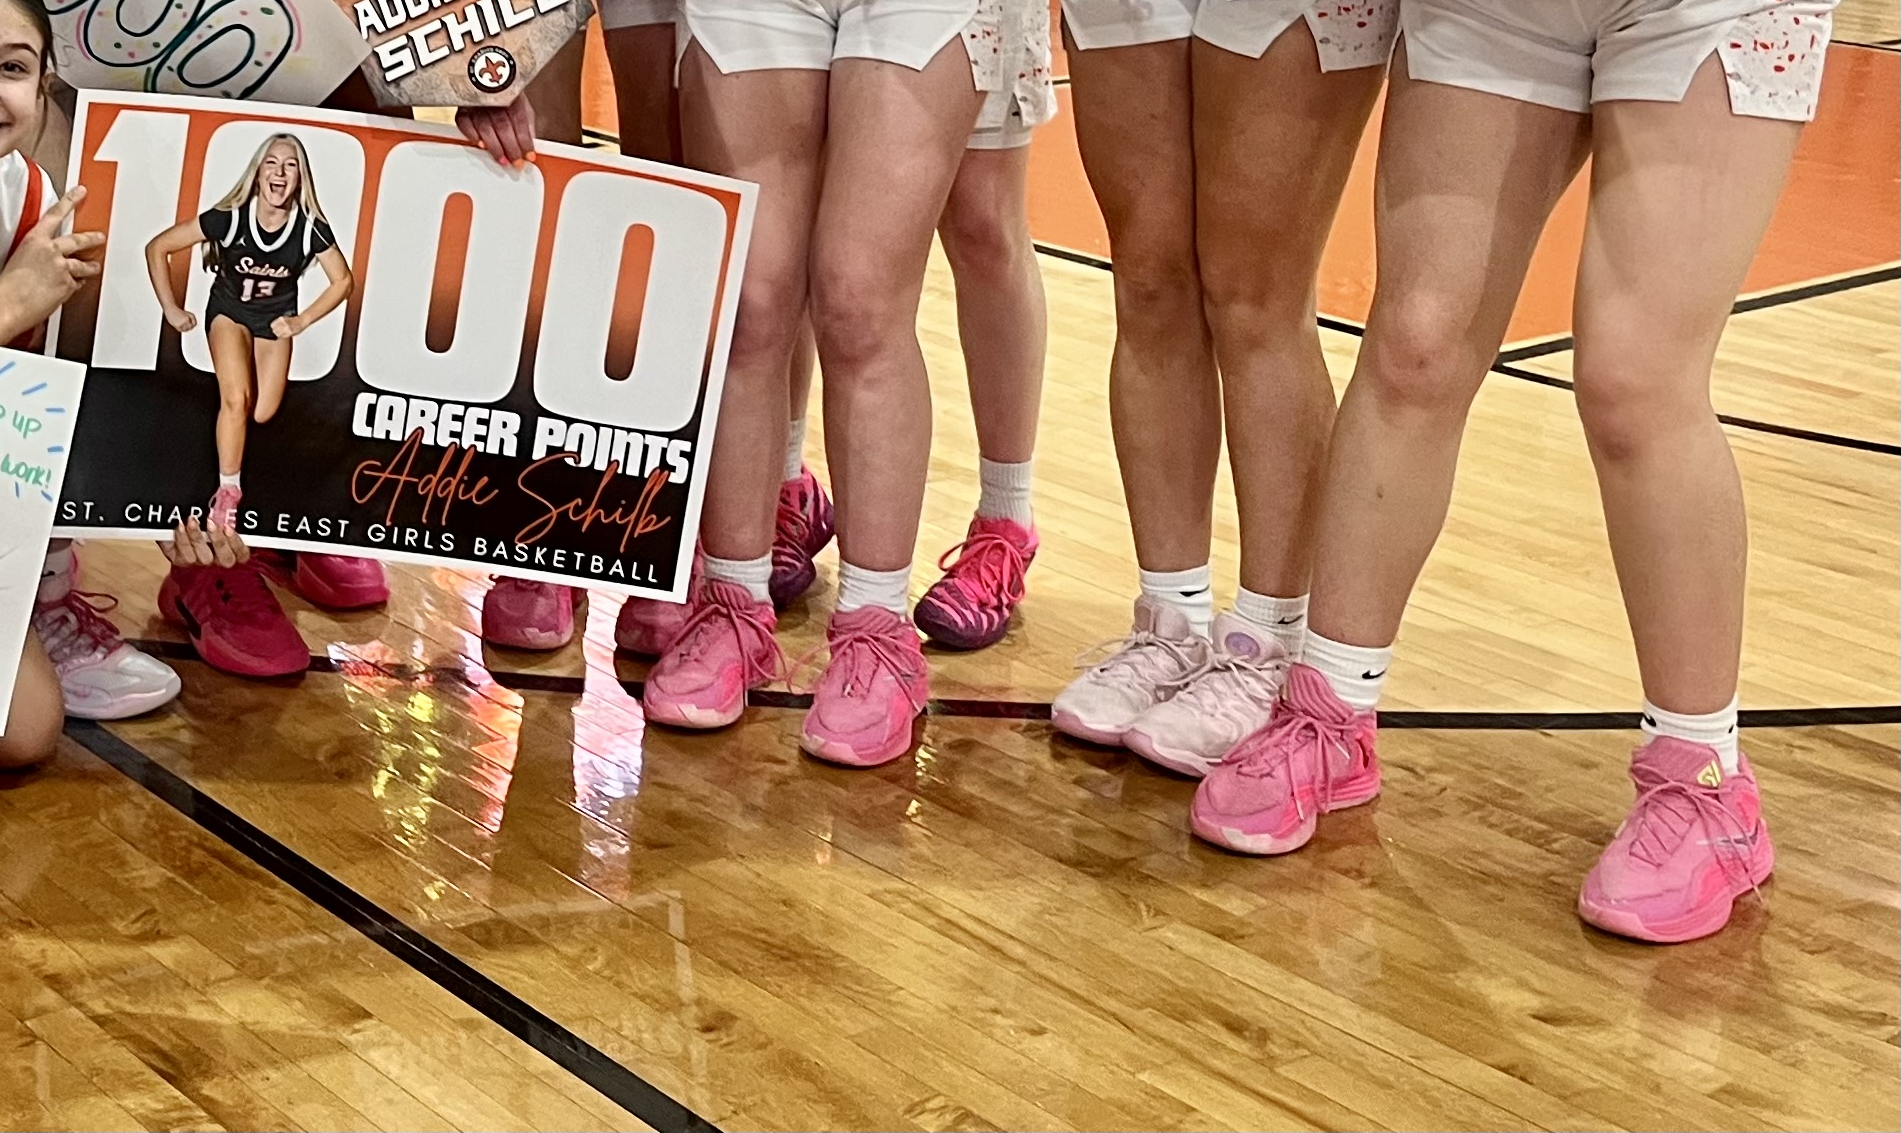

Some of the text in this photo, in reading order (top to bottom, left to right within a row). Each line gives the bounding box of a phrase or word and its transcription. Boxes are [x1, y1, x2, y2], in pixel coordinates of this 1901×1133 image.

[92, 109, 729, 433] 1000
[12, 409, 42, 439] up
[353, 392, 692, 486] CAREER POINTS
[0, 453, 52, 489] work!
[351, 429, 674, 554] Addie Schilb
[62, 500, 661, 585] ST. CHARES EAST GIRLS BASKETBALL
